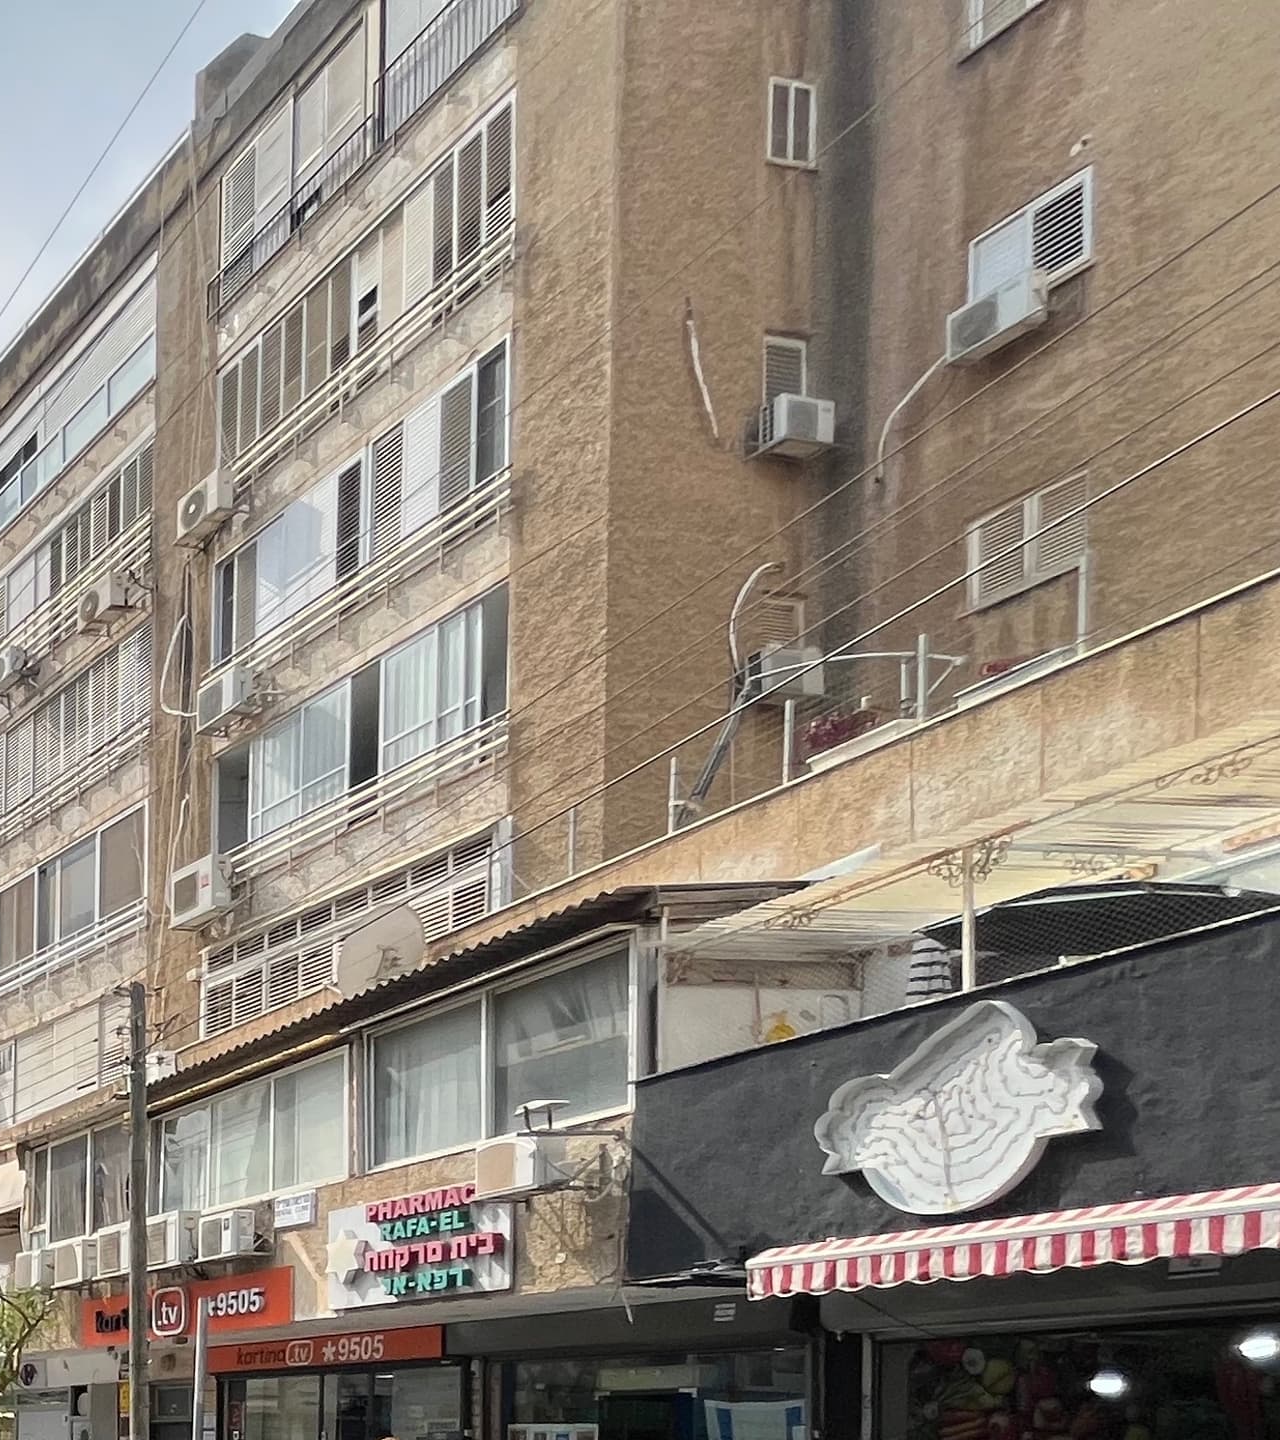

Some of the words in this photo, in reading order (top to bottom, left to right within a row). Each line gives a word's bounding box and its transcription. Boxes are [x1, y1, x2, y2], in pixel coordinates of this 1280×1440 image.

[365, 1183, 476, 1223] PHARMAC
[380, 1210, 466, 1243] RAFA-EL
[450, 1233, 496, 1260] בית
